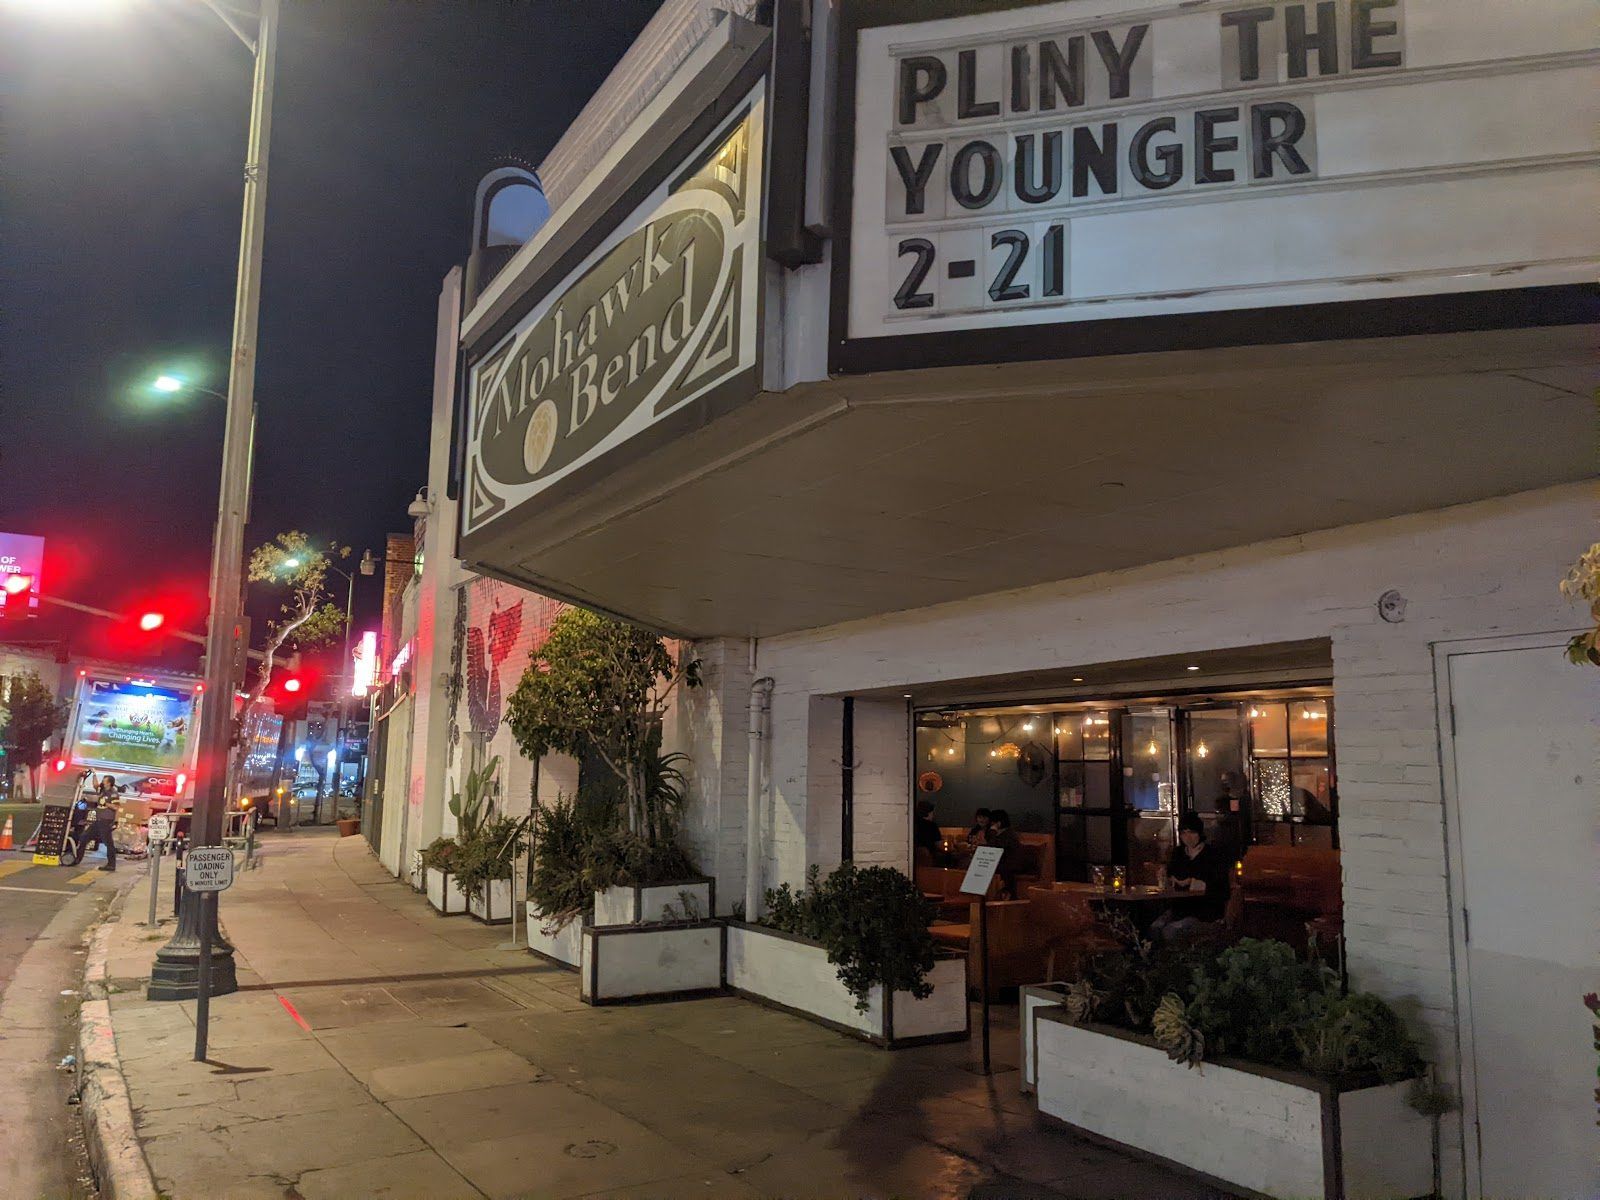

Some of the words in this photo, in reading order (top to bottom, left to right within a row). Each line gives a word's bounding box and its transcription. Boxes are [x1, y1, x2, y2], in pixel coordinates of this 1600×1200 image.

[900, 24, 1149, 125] PLINY
[1221, 0, 1402, 81] THE
[890, 102, 1310, 214] YOUNGER
[894, 225, 1065, 309] 2-21
[494, 221, 672, 438] Mohawk
[565, 236, 696, 439] Bend
[1, 556, 16, 564] OF
[108, 731, 142, 743] Changing
[190, 853, 230, 861] PASSENGER
[194, 862, 225, 870] LOADING
[200, 871, 218, 879] ONLY
